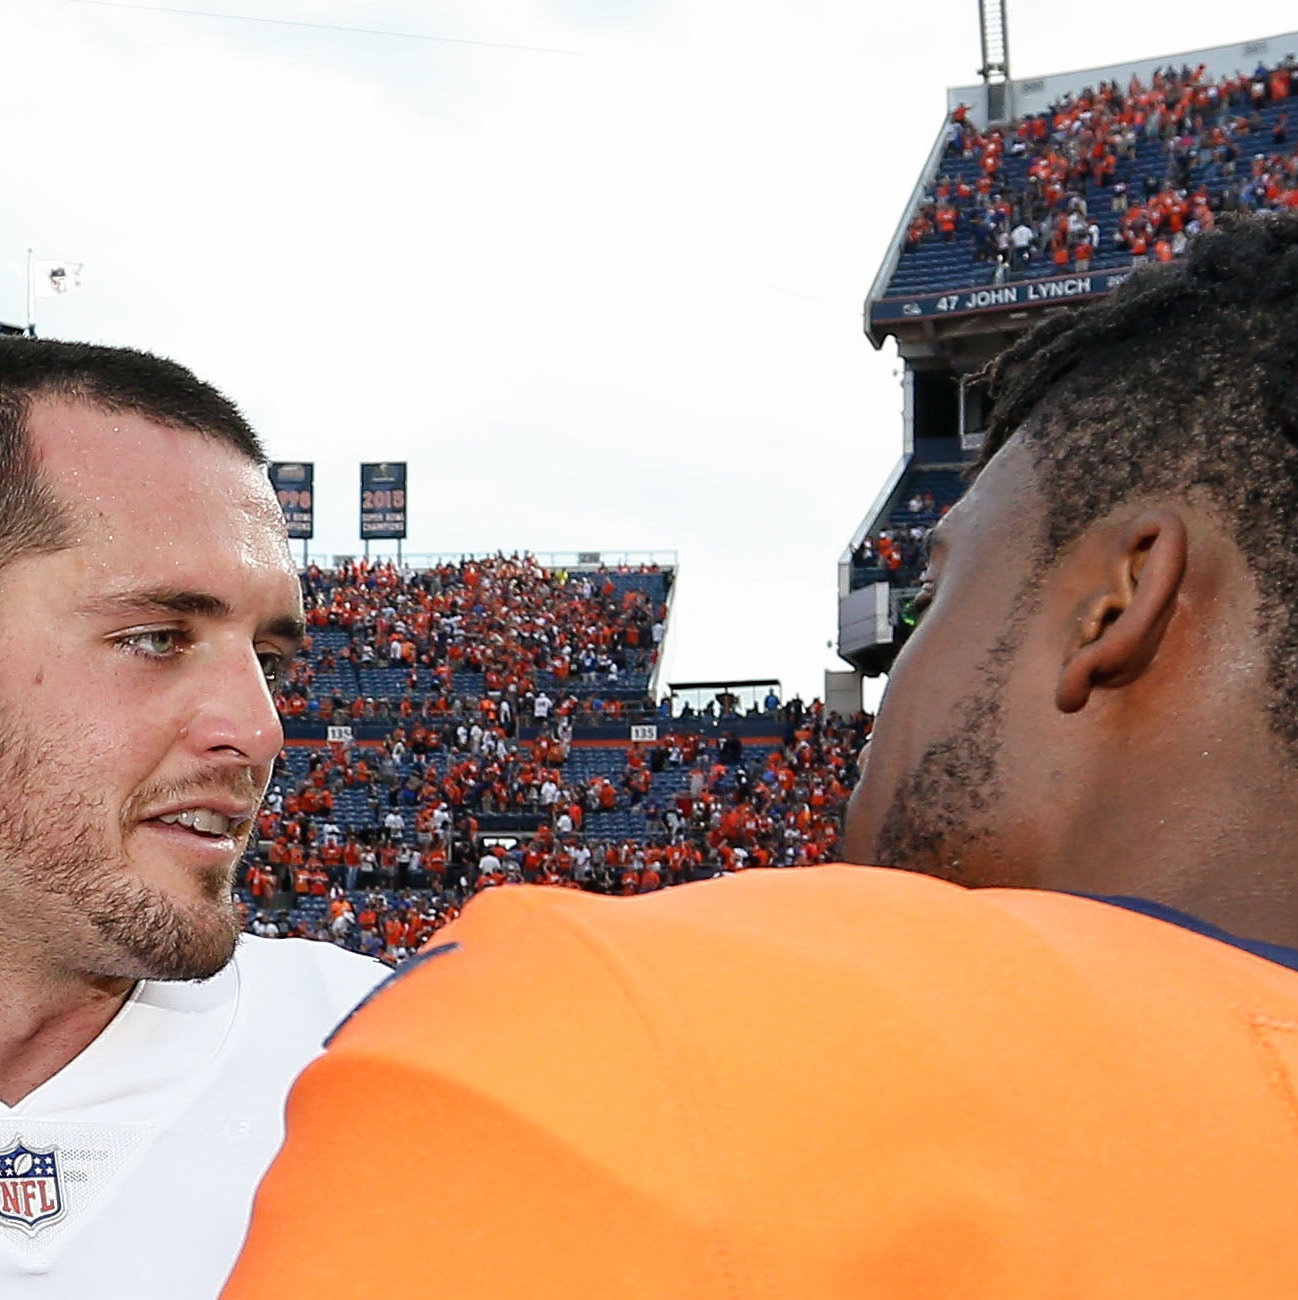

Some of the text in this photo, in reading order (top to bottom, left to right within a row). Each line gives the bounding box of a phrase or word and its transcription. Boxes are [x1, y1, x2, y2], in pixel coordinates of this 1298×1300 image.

[936, 296, 960, 312] 47
[965, 286, 1017, 309] JOHN
[1027, 277, 1092, 300] LYNCH
[633, 726, 655, 740] 135
